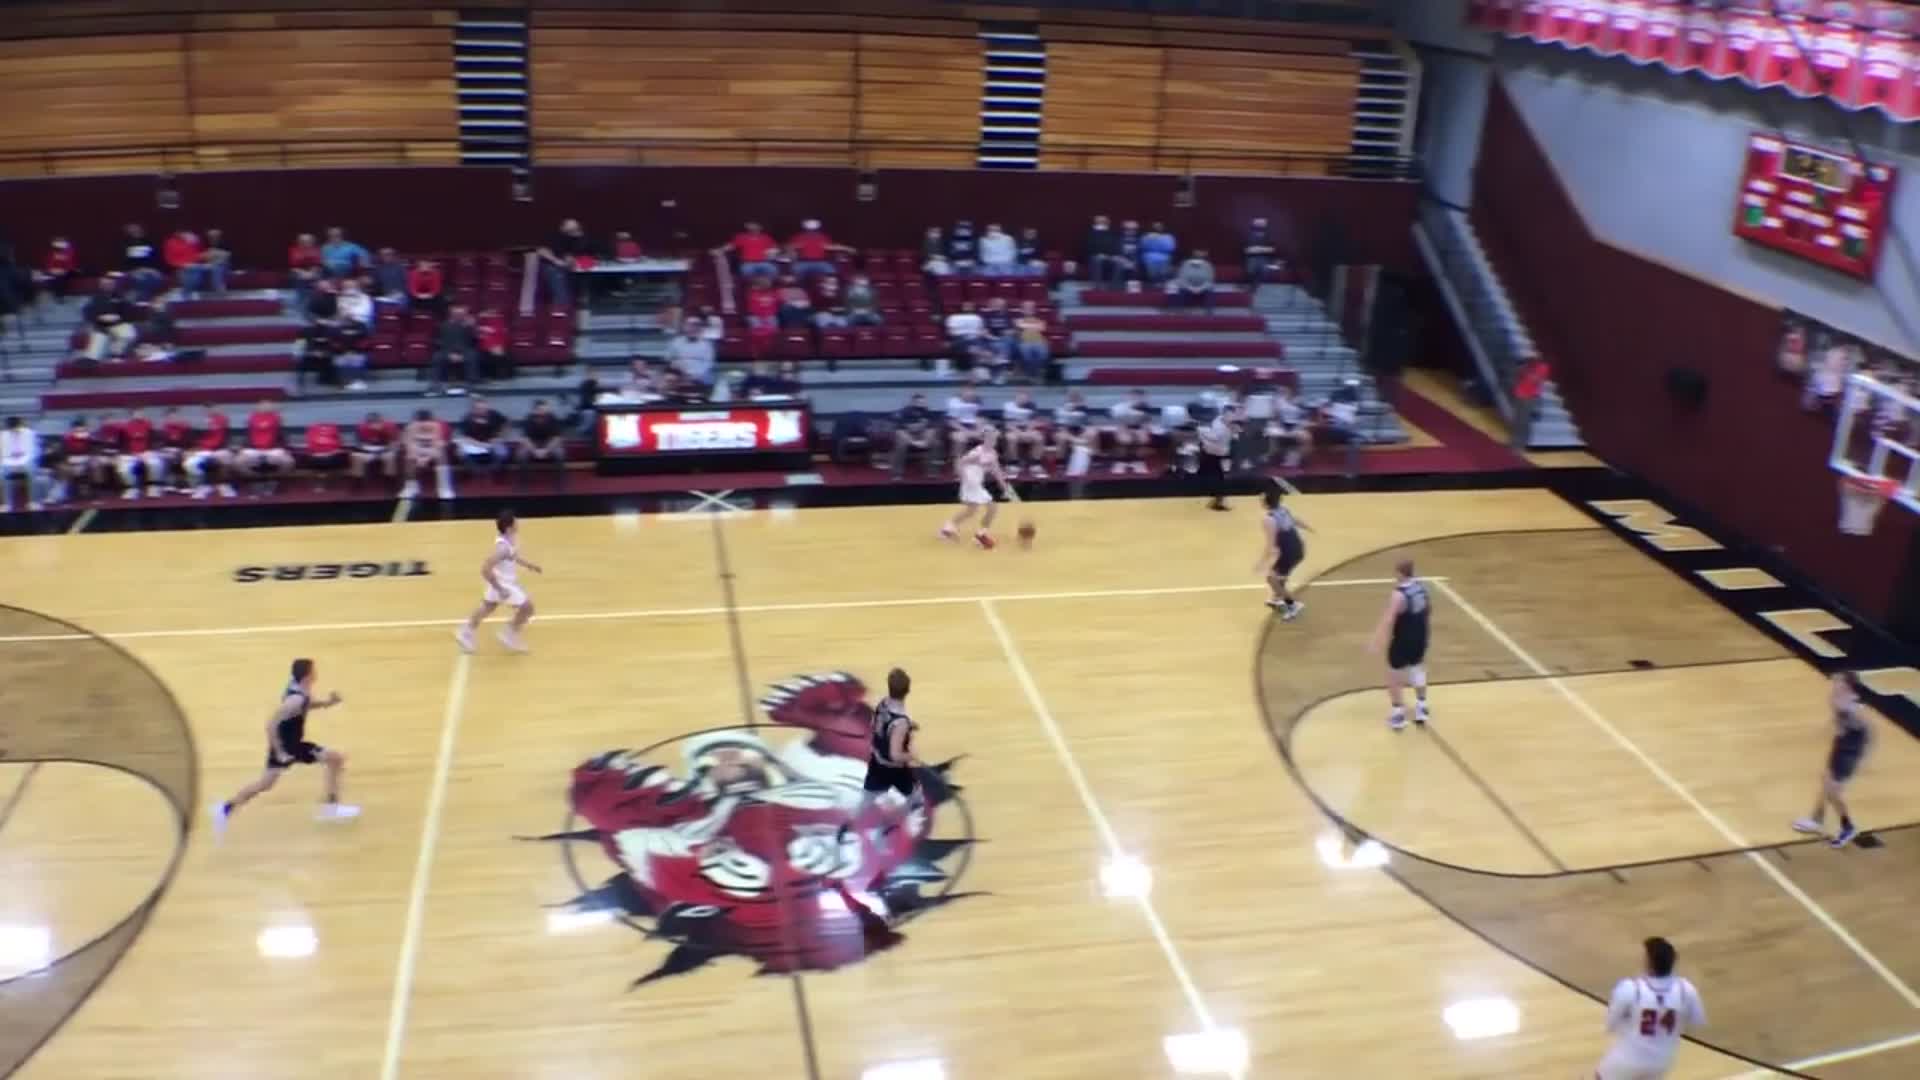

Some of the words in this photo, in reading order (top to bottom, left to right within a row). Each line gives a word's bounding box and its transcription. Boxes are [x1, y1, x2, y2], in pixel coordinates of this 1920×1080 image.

[650, 422, 758, 450] TIGERS
[233, 560, 433, 583] TIGERS
[1640, 1008, 1677, 1036] 24
